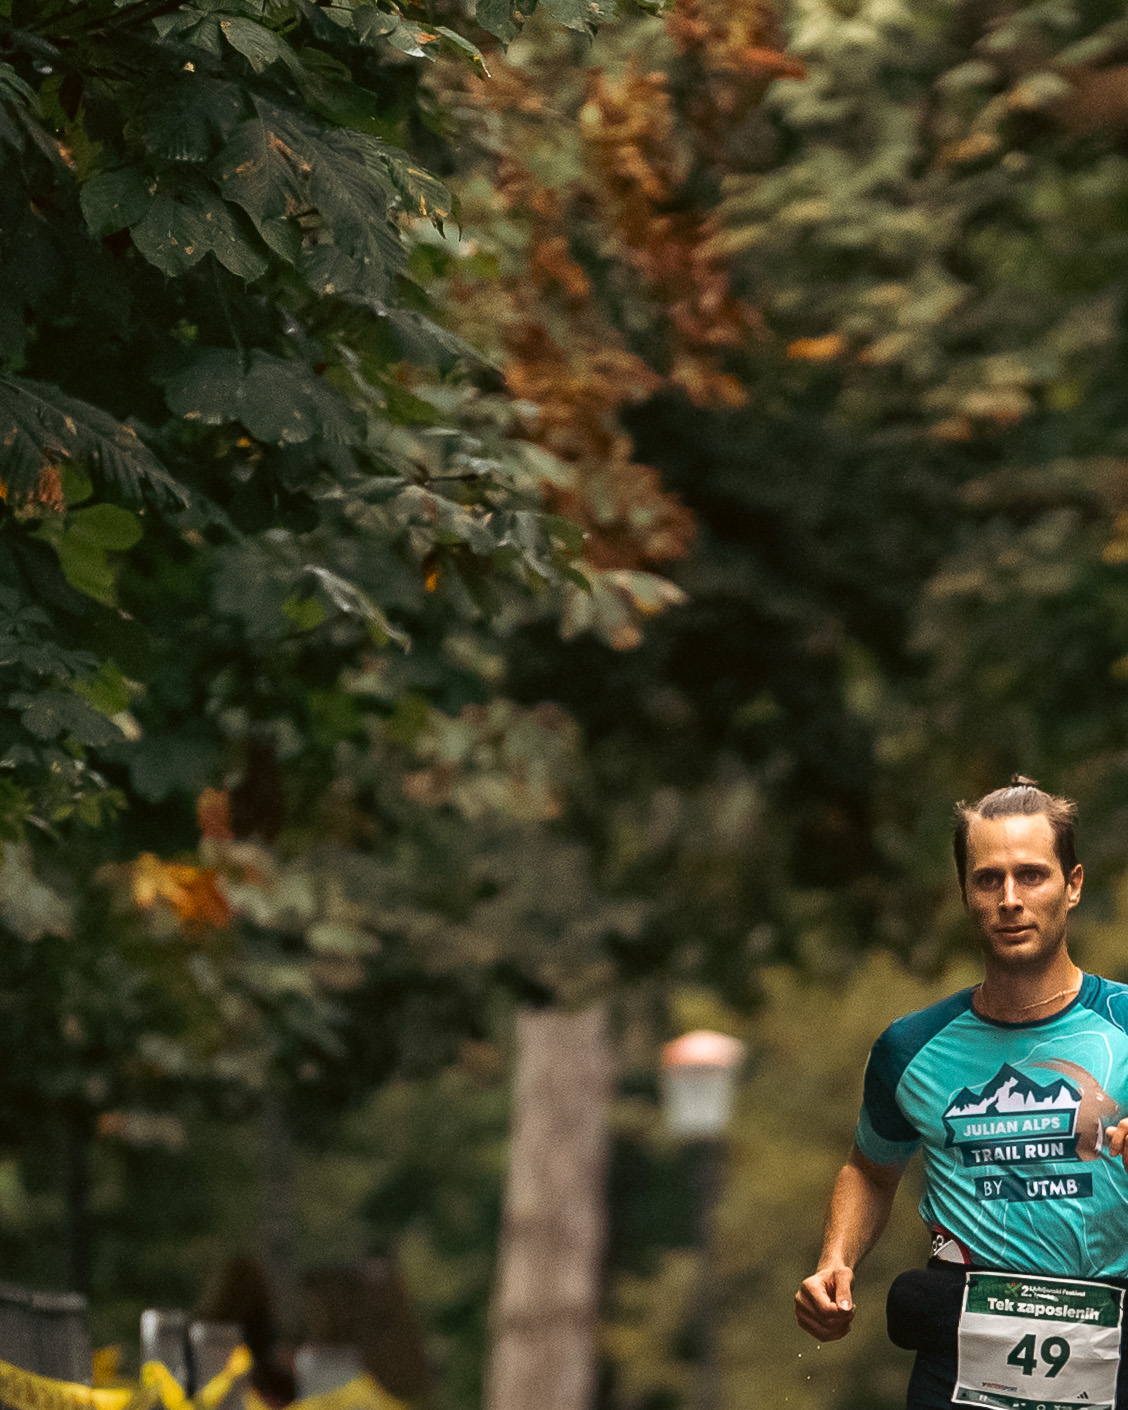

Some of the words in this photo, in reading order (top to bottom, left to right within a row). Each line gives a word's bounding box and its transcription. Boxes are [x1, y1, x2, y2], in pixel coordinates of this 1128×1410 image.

[963, 1122, 1018, 1138] JULIAN
[1021, 1117, 1061, 1132] ALPS
[971, 1146, 1021, 1164] TRAIL
[1025, 1142, 1065, 1159] RUN
[983, 1180, 1003, 1197] BY
[1026, 1178, 1078, 1198] UTMB
[987, 1297, 1015, 1313] Tek
[1017, 1301, 1100, 1321] zaposlenih
[1006, 1333, 1071, 1379] 49
